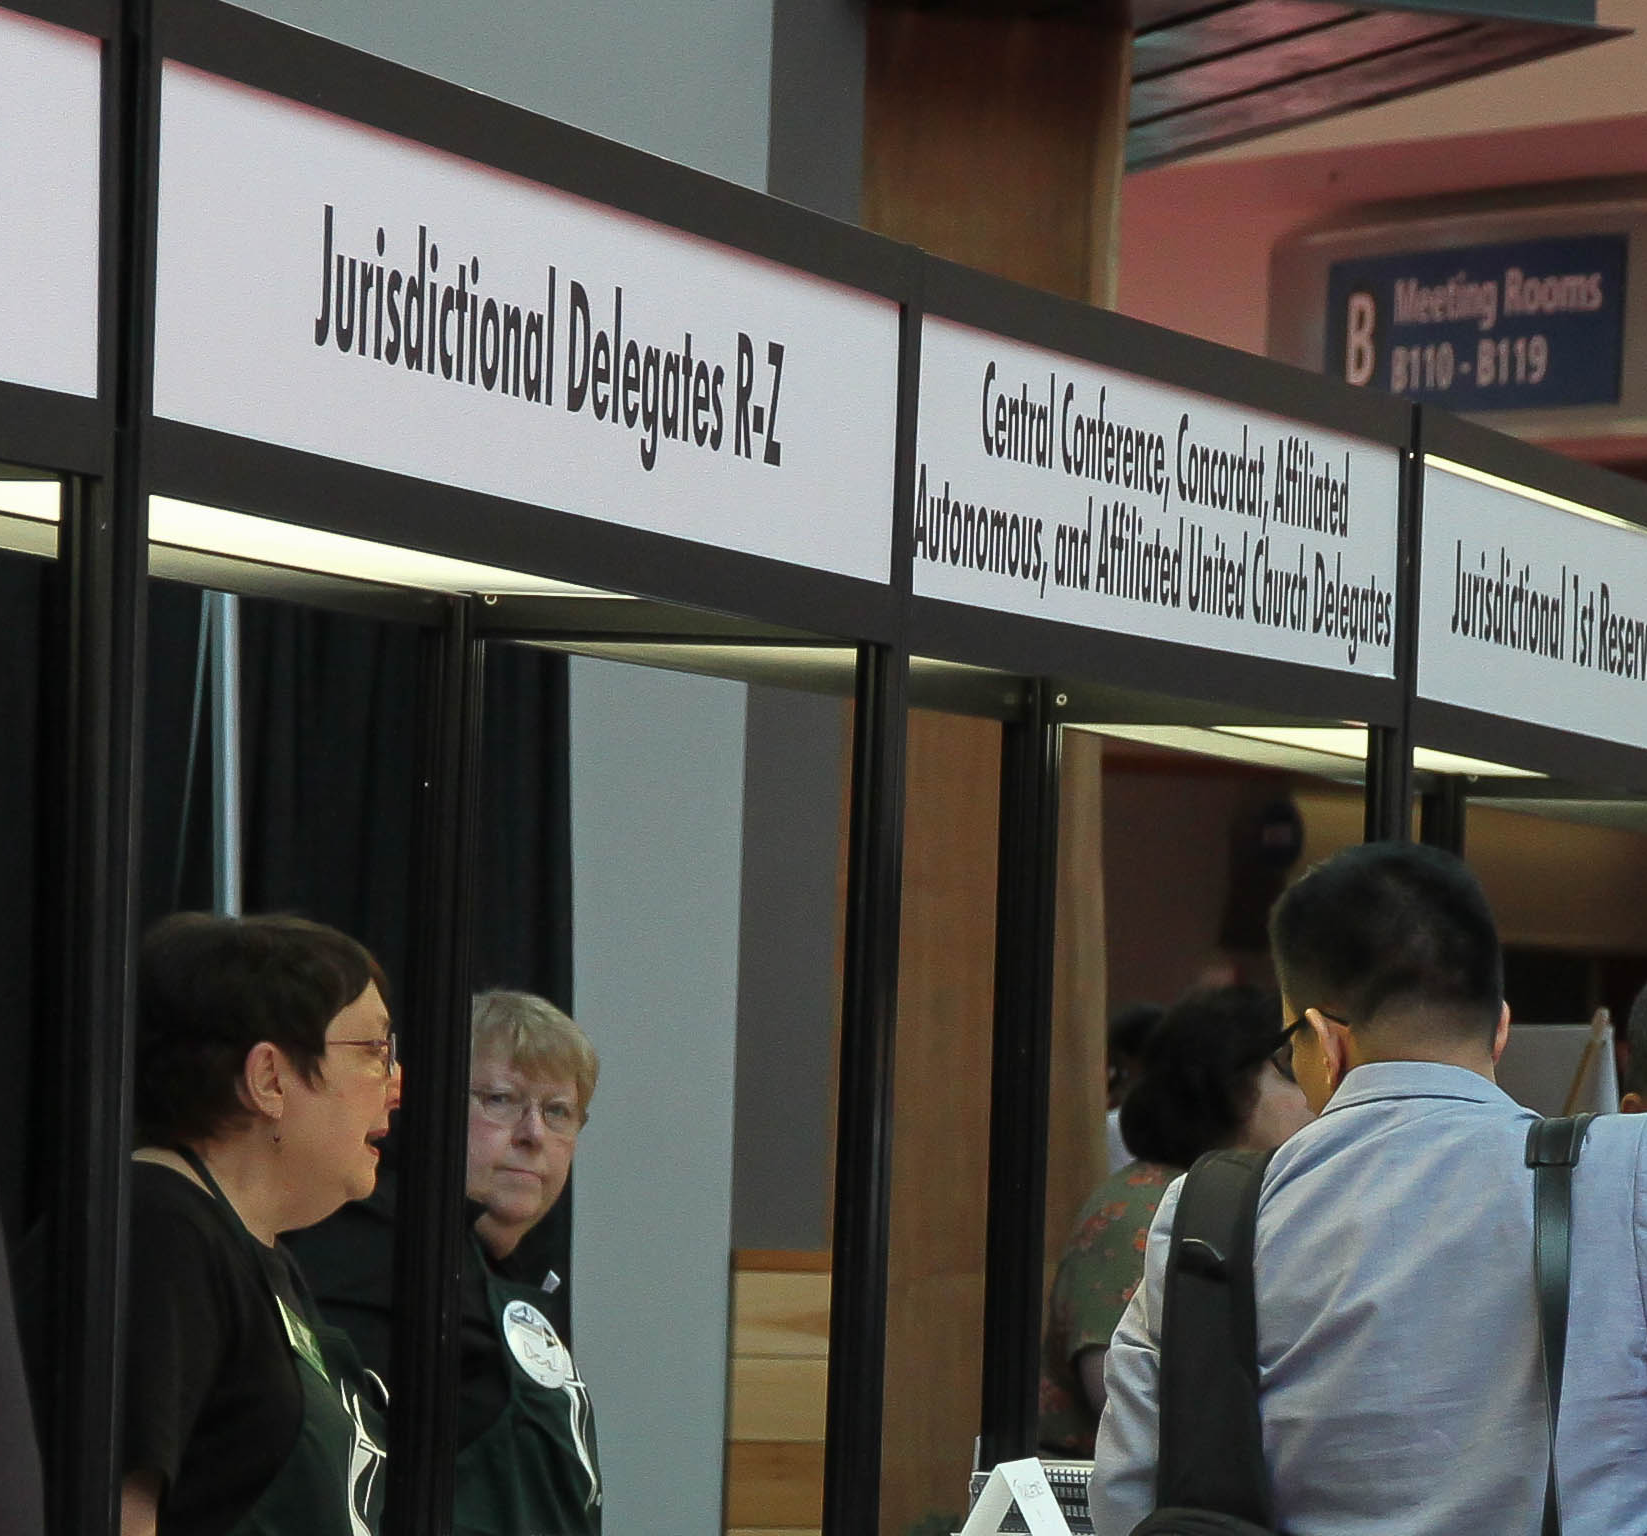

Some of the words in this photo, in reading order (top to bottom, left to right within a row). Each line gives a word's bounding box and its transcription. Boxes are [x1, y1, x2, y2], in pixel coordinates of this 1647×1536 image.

[314, 204, 557, 407] Jurisdictional
[566, 279, 725, 472] Delegates
[734, 332, 785, 468] R-Z
[1345, 292, 1376, 386] B
[1393, 270, 1498, 331] Meeting
[1504, 267, 1604, 315] Rooms
[1391, 341, 1452, 393] B110
[1476, 334, 1548, 386] B119
[982, 361, 1056, 470] Central
[1061, 382, 1171, 512] Conference,
[1177, 413, 1268, 533] Concordat,
[1273, 436, 1350, 538] Affiliated
[914, 464, 1048, 599] Autonomous,
[1054, 496, 1093, 590] and
[1096, 500, 1185, 608] Affiliated
[1188, 524, 1248, 621] United
[1254, 534, 1307, 633] Church
[1313, 551, 1392, 659] Delegates
[1451, 540, 1566, 660] Jurisdictional
[1573, 574, 1594, 668] 1st
